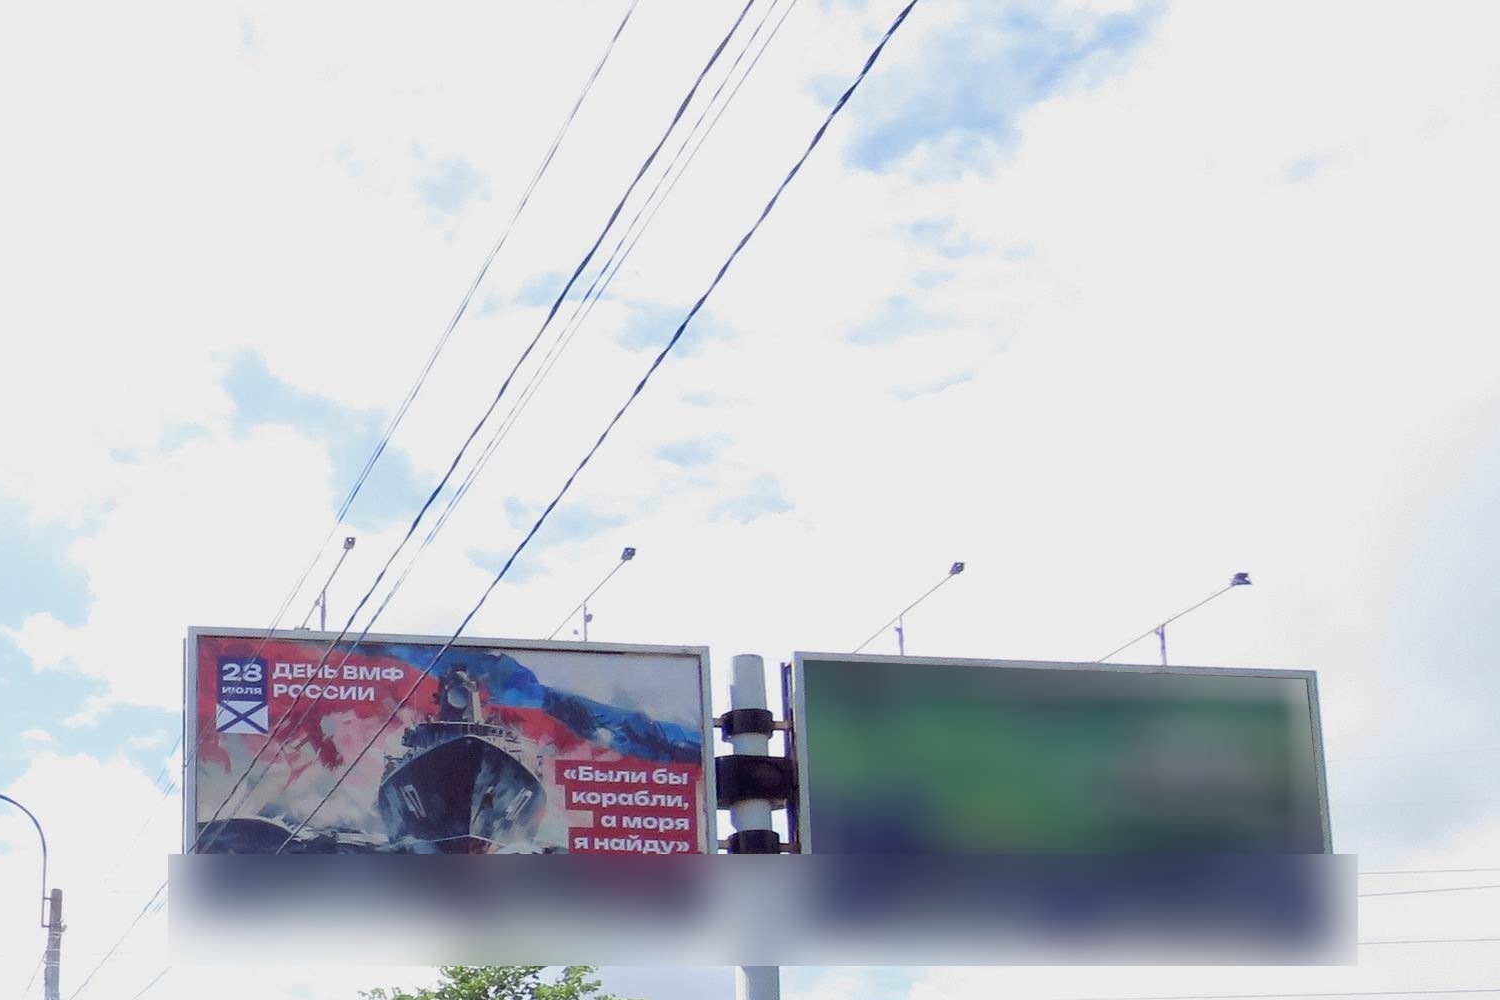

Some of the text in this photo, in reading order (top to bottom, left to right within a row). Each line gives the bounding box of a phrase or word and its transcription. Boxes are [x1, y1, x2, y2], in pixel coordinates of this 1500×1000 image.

[221, 663, 262, 682] 28
[272, 662, 404, 682] ДЕНЬ ВМФ
[273, 684, 375, 701] РОССИИ
[563, 766, 689, 785] «Были бы
[572, 790, 689, 810] корабли,
[601, 815, 690, 833] а моря
[574, 835, 690, 855] я найду»
